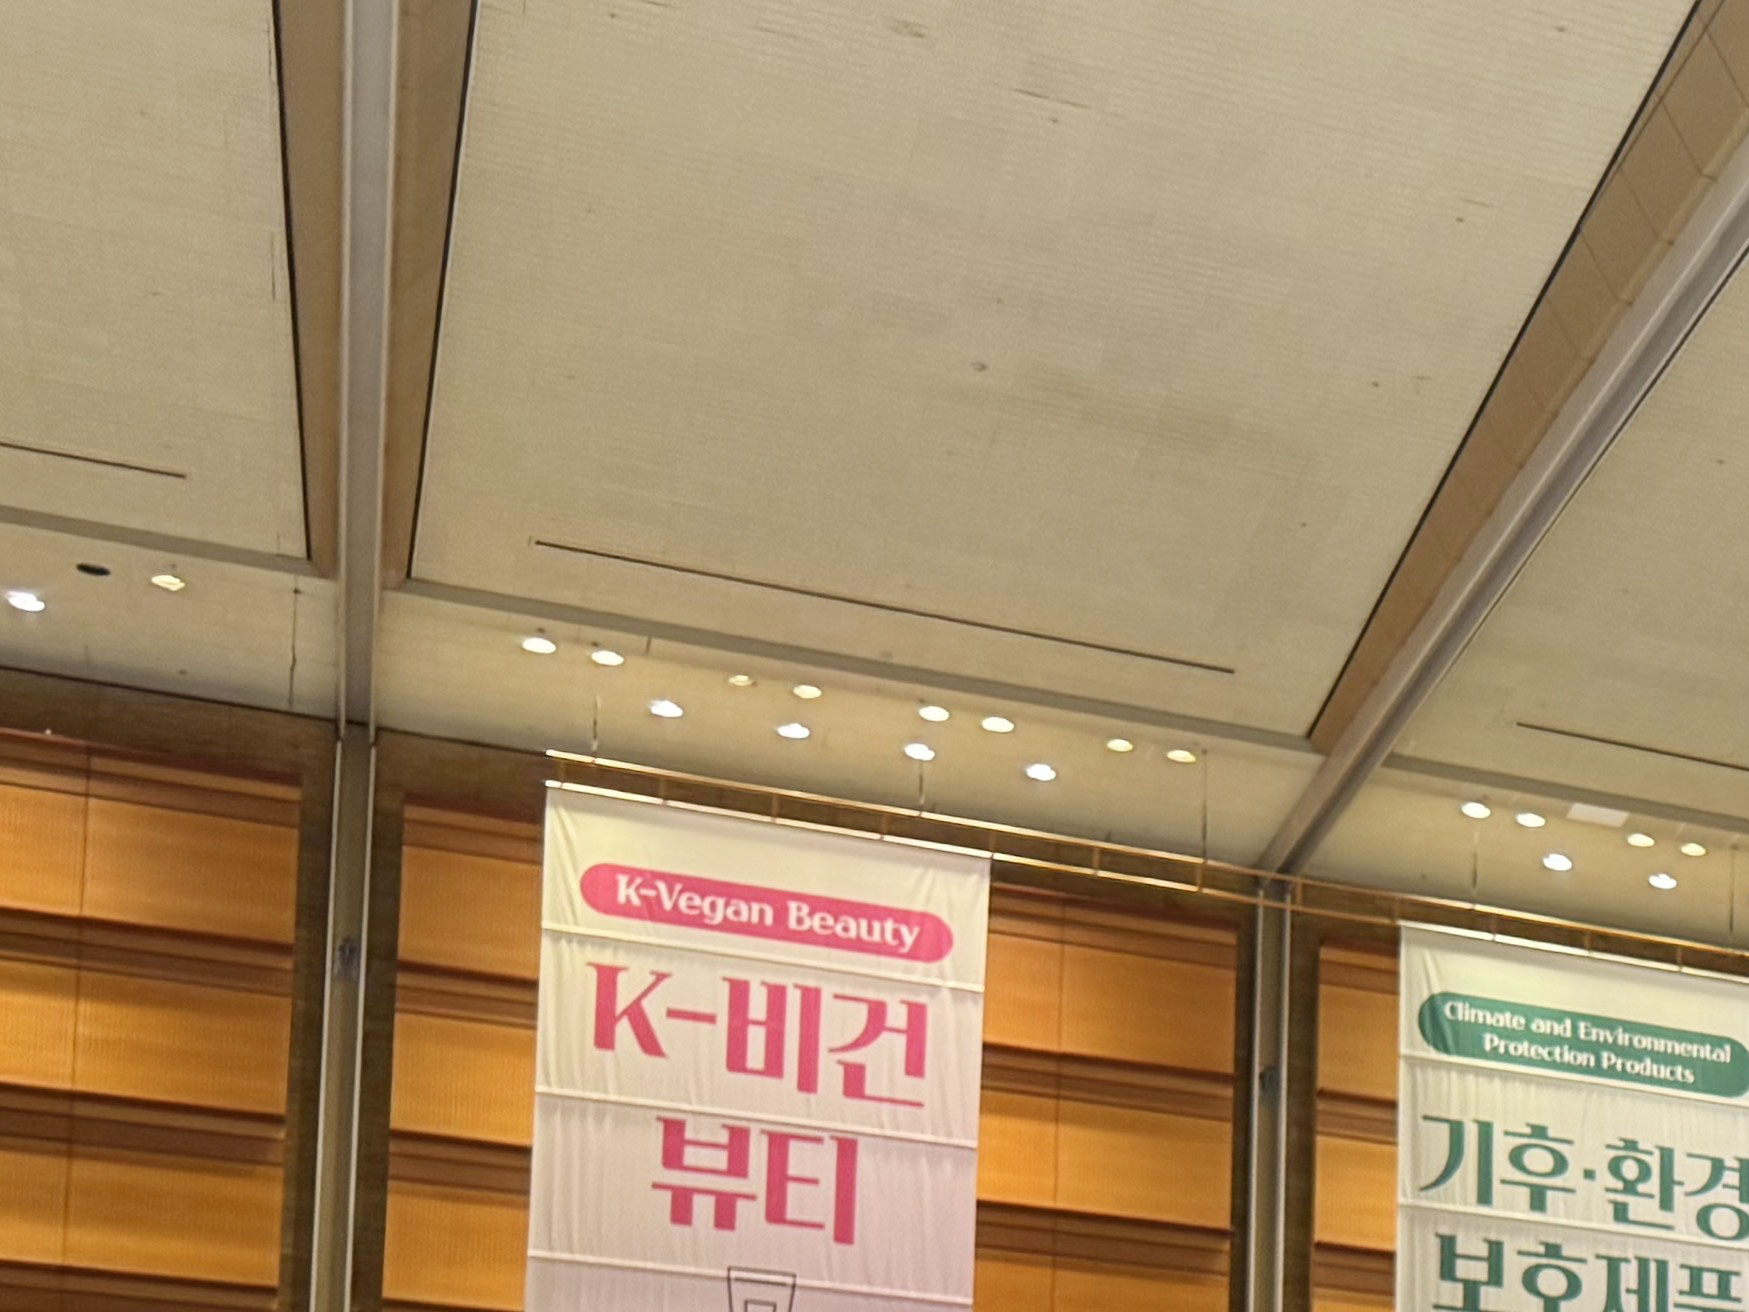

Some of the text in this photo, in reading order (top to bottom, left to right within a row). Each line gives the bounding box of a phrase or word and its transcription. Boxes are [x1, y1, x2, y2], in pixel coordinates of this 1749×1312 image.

[616, 873, 920, 953] K-Vegan Beauty
[587, 962, 928, 1108] K-비건
[1444, 1001, 1732, 1065] Climate and Environmental
[1484, 1032, 1695, 1085] Protection Products
[651, 1116, 858, 1246] 뷰티
